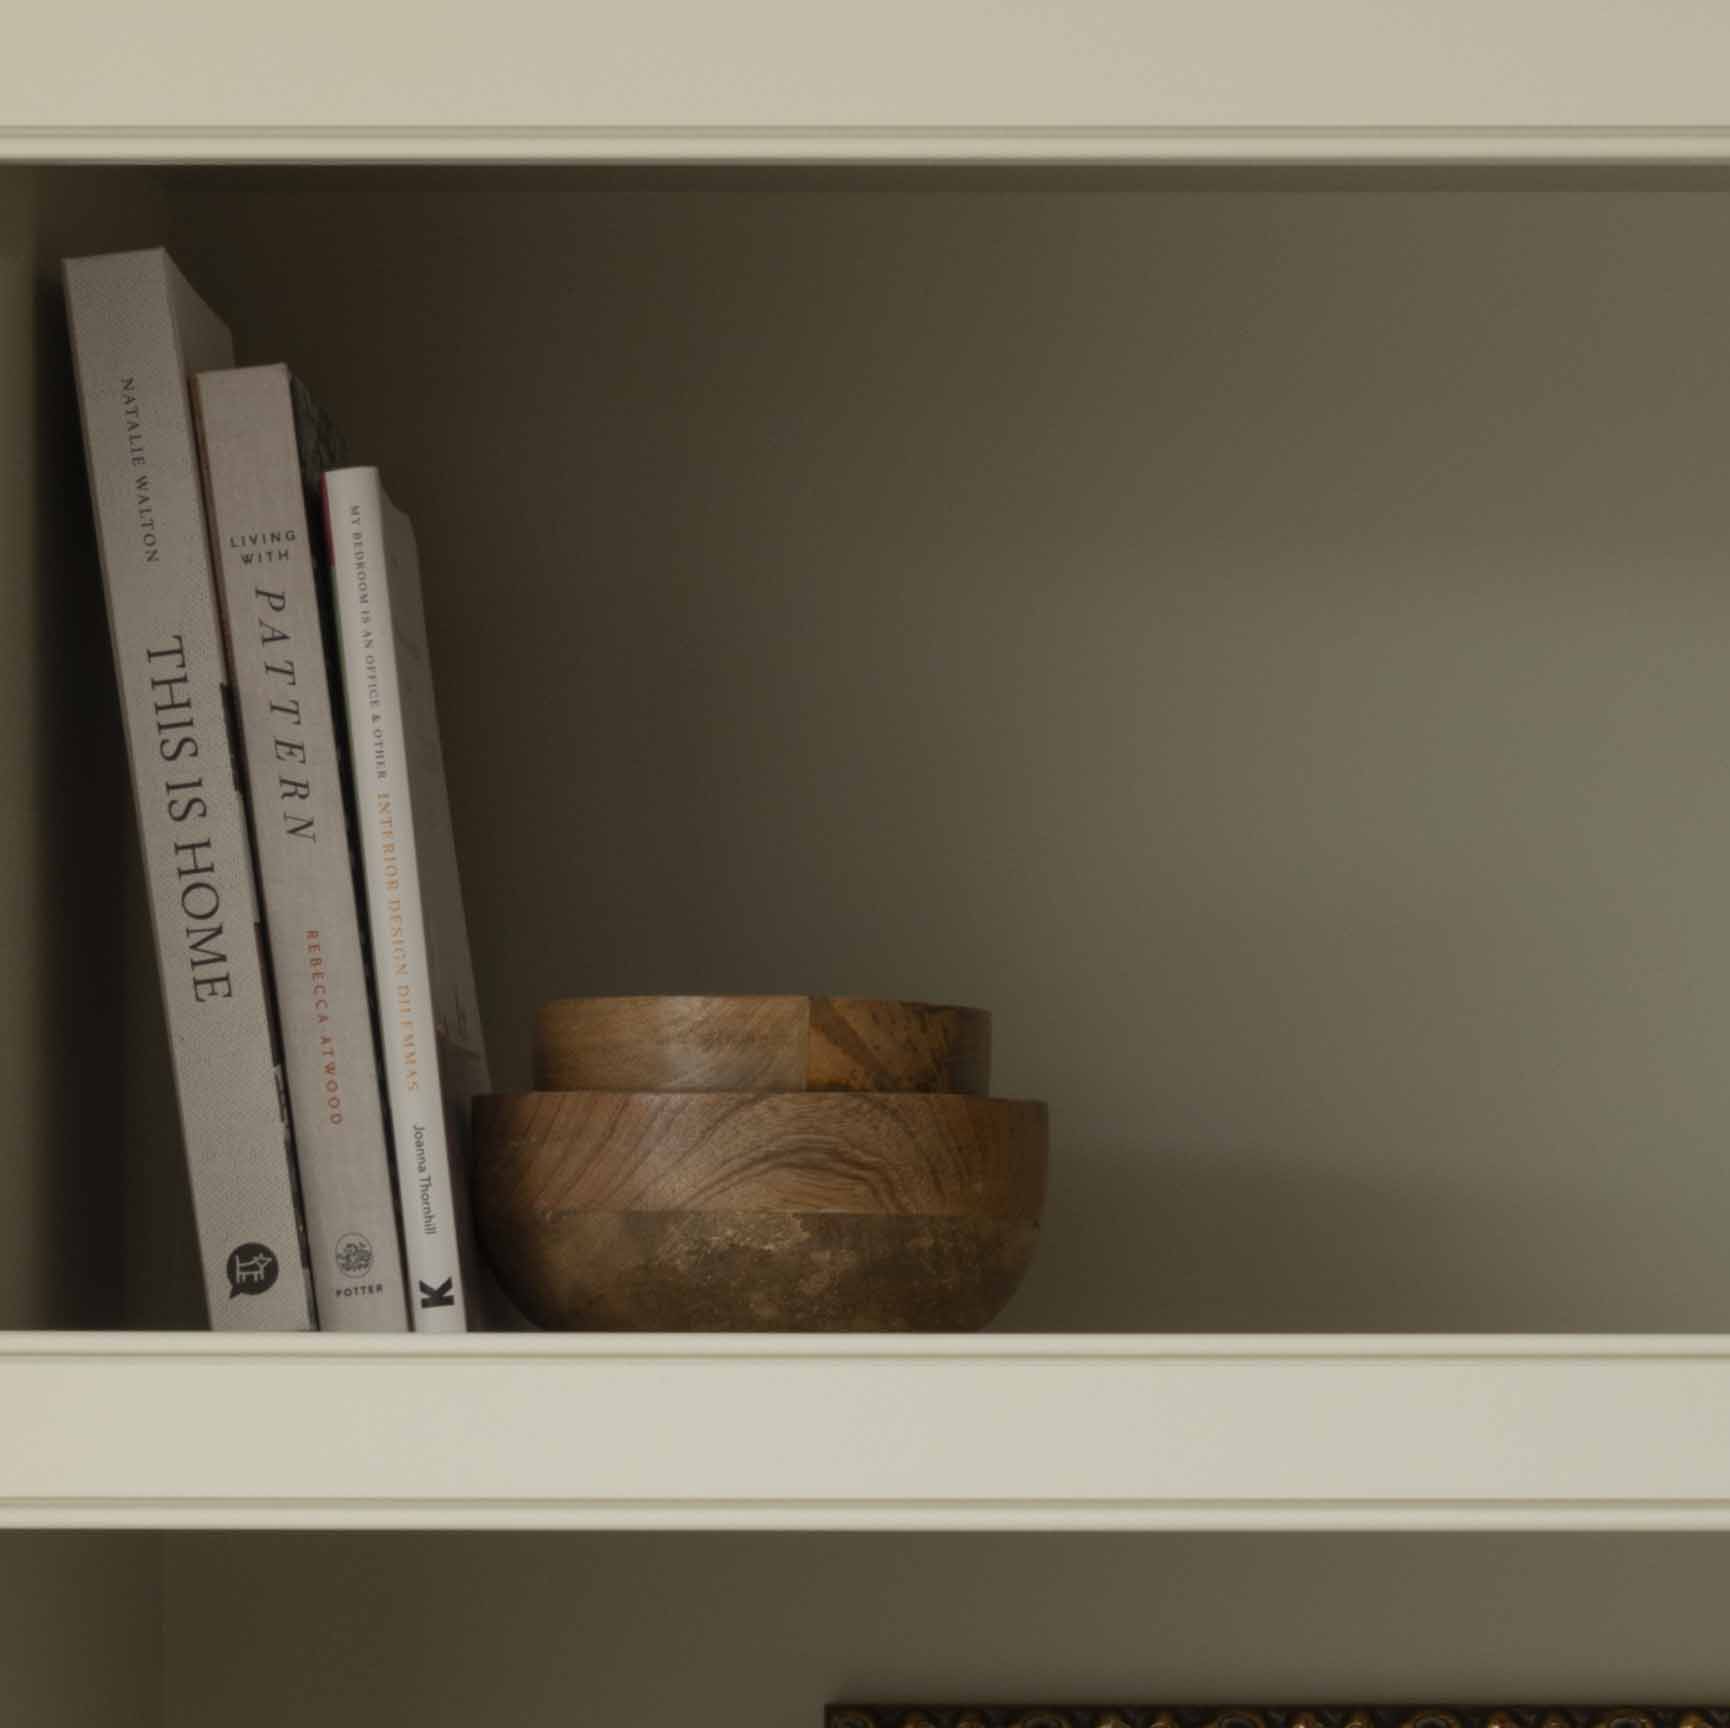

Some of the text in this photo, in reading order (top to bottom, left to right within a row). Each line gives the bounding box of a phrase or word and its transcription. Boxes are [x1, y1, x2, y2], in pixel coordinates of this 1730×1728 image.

[120, 377, 160, 563] NATALIE WALTON
[229, 529, 297, 548] LIVING
[351, 504, 361, 526] MY
[241, 549, 290, 565] WITH
[352, 531, 369, 604] BEDROOM
[360, 630, 375, 649] AN
[255, 585, 317, 843] PATTERN
[373, 728, 387, 780] OTHER
[146, 634, 234, 1003] THIS IS HOME
[305, 930, 343, 1125] REBECCA ATWOOD
[413, 1124, 437, 1236] Joanna Thornhill
[335, 1283, 384, 1298] POTTER
[418, 1277, 456, 1309] K
